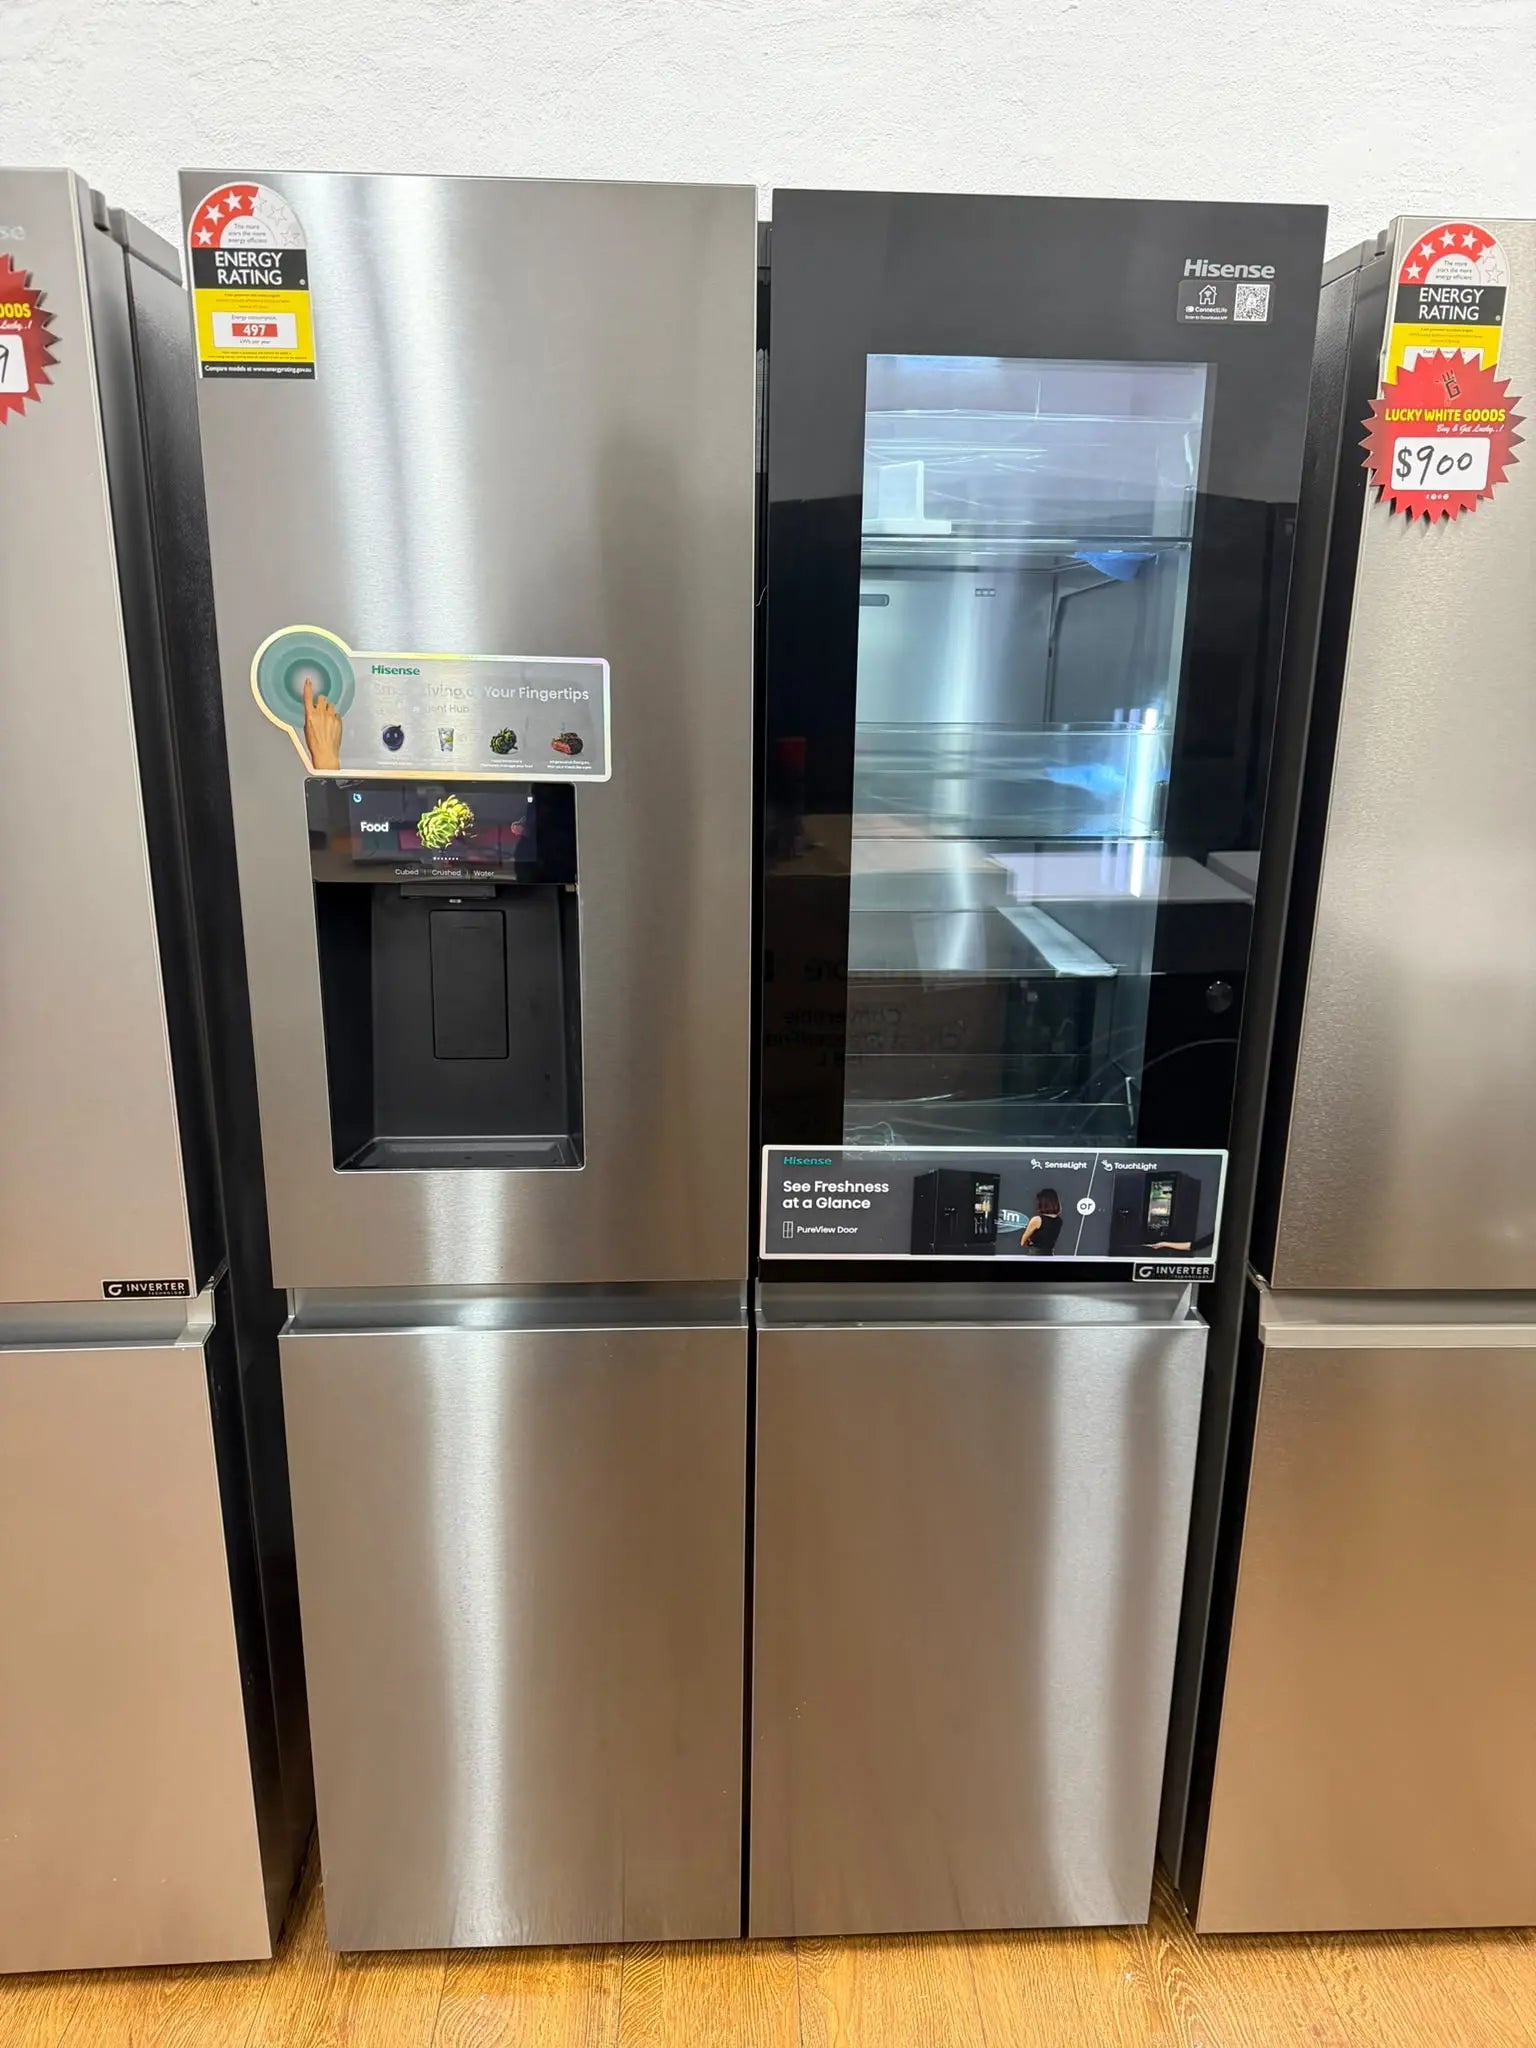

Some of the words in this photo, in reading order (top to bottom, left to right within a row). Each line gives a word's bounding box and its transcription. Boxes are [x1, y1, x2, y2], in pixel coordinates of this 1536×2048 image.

[214, 251, 283, 268] ENERGY
[1183, 258, 1276, 279] Hisense
[217, 268, 283, 286] RATING
[1419, 287, 1485, 304] ENERGY
[1418, 304, 1480, 321] RATING
[243, 324, 266, 336] 497
[1385, 408, 1422, 421] LUCKY
[1423, 408, 1461, 422] WHITE
[1463, 408, 1506, 422] GOODS
[1436, 424, 1450, 433] Buy
[1451, 424, 1459, 432] &
[1459, 424, 1472, 434] Get
[1395, 445, 1473, 486] $900
[371, 665, 421, 676] Hisense
[427, 683, 464, 700] iving
[484, 685, 516, 698] Your
[519, 686, 590, 704] Fingertips
[449, 704, 470, 713] Hub
[360, 821, 390, 832] Food
[431, 868, 462, 876] Crushed
[473, 869, 495, 877] Water
[783, 1156, 833, 1166] Hisense
[1044, 1160, 1088, 1170] SenseLight
[1114, 1161, 1158, 1171] TouchLight
[783, 1180, 811, 1193] See
[814, 1180, 890, 1193] Freshness
[782, 1197, 800, 1209] at
[802, 1199, 812, 1209] a
[815, 1196, 871, 1209] Glance
[1079, 1202, 1092, 1211] or
[1002, 1209, 1020, 1222] 1m
[796, 1225, 836, 1234] PureView
[837, 1225, 858, 1234] Door
[1156, 1266, 1210, 1275] INVERTER
[126, 1282, 185, 1292] INVERTER
